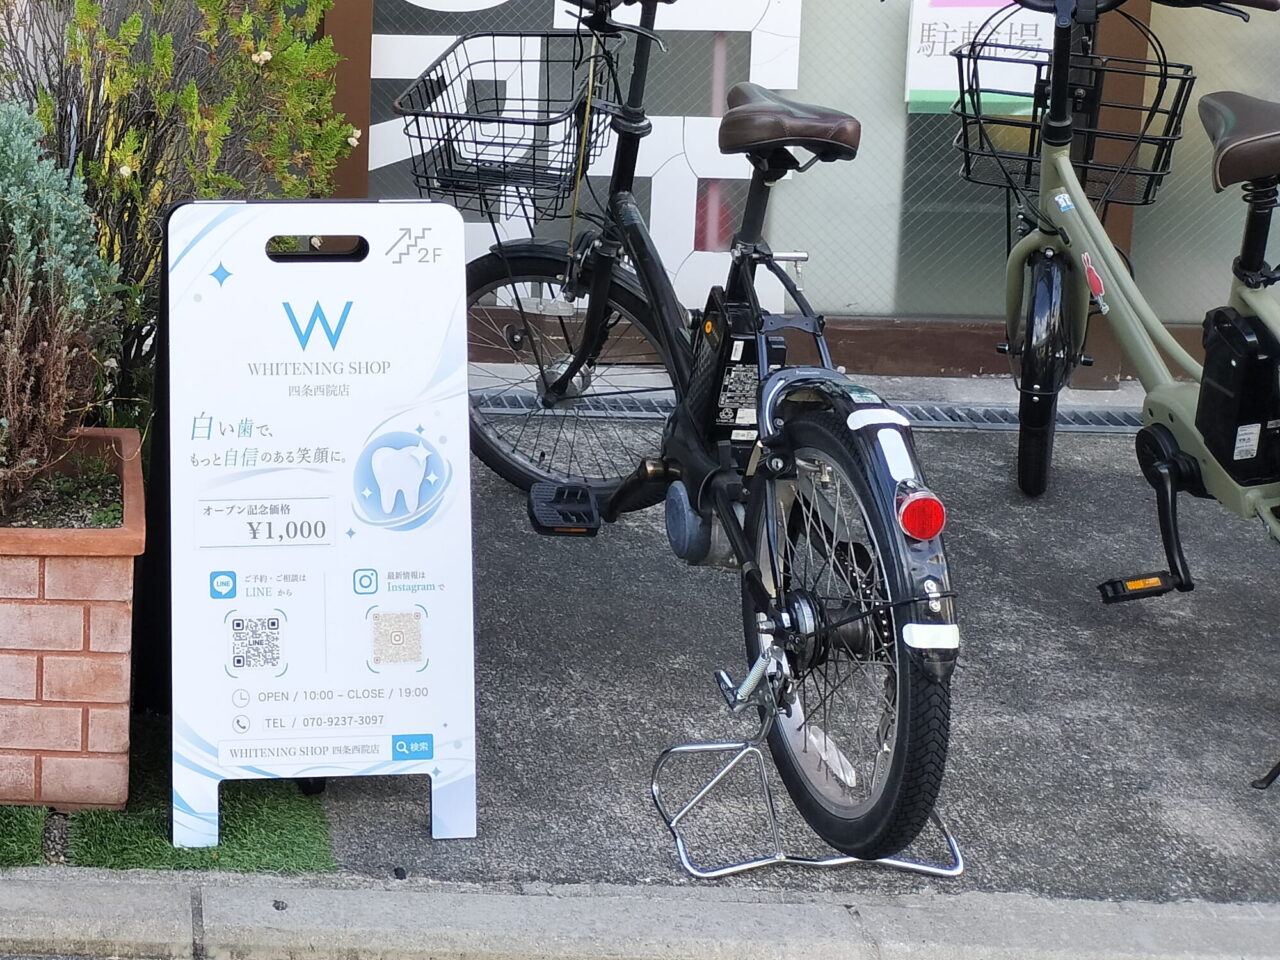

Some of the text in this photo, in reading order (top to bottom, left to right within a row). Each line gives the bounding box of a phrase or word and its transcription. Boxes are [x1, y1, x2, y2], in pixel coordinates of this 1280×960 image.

[917, 21, 1041, 60] 駐輪場
[417, 247, 443, 263] 2F
[282, 300, 354, 352] W
[247, 360, 391, 377] WHITENING SHOP
[287, 383, 351, 398] 四条西院店
[190, 411, 274, 441] 白い歯で、
[190, 446, 347, 468] もっと自信のある笑顔に。
[202, 503, 292, 517] オープン記念価格
[247, 519, 327, 542] ¥1,000
[216, 580, 231, 588] LINE
[387, 581, 436, 593] Instagram
[245, 586, 293, 598] LINE から
[258, 691, 289, 702] OPEN
[303, 690, 334, 701] 10:00
[347, 688, 385, 700] CLOSE
[399, 687, 429, 698] 19:00
[265, 718, 286, 729] TEL
[303, 715, 385, 727] 070-9237-3097
[229, 746, 297, 759] WHITENING
[299, 745, 329, 757] SHOP
[410, 742, 429, 753] 検索
